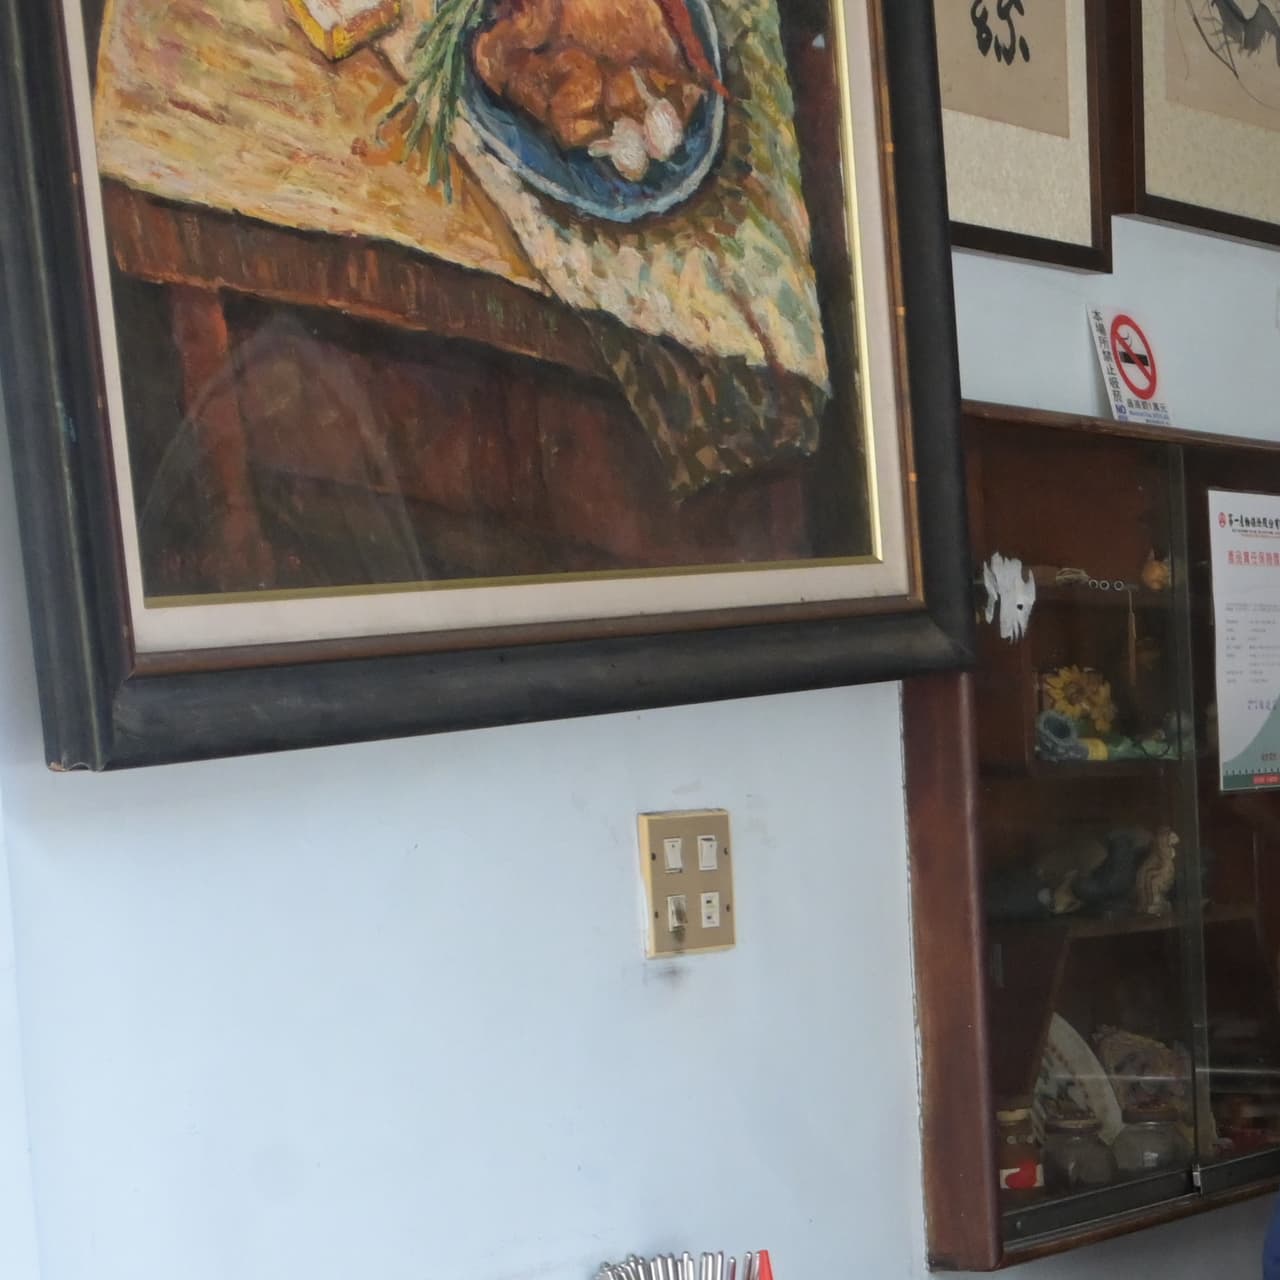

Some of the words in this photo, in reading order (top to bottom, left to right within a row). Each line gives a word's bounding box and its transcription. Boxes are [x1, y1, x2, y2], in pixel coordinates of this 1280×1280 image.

[1092, 310, 1122, 403] 本場所禁止吸菸
[1115, 403, 1127, 415] NO
